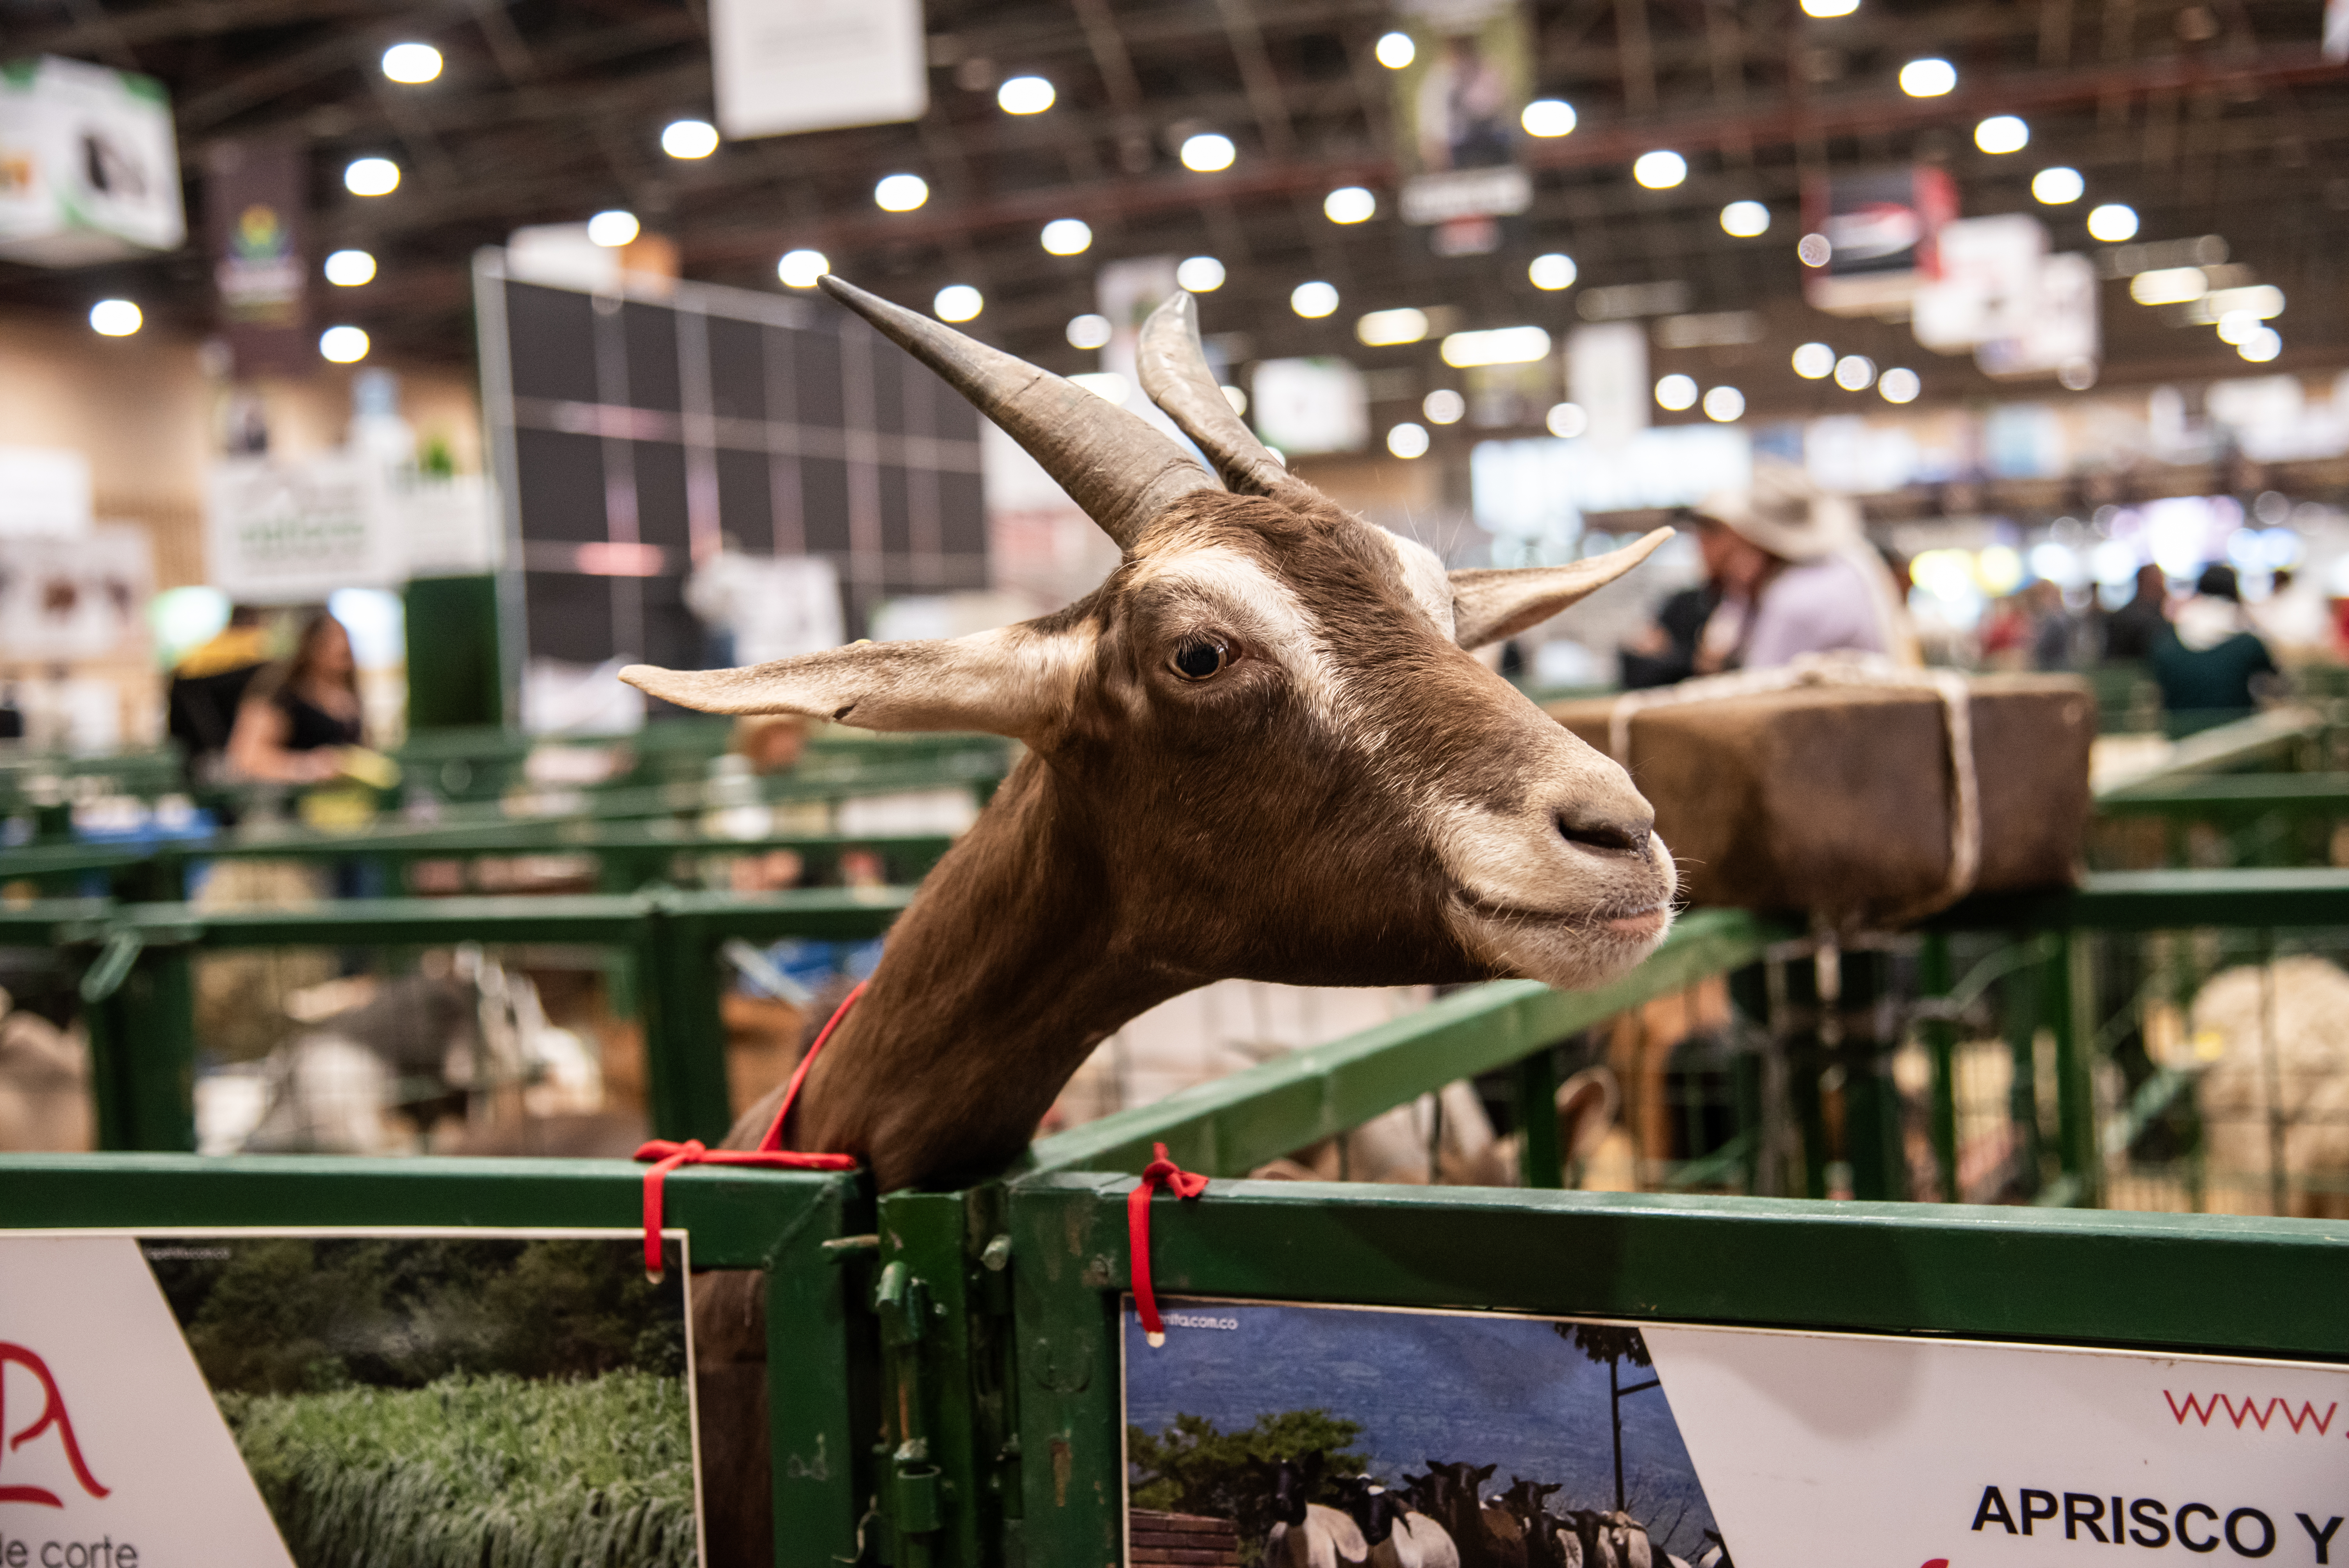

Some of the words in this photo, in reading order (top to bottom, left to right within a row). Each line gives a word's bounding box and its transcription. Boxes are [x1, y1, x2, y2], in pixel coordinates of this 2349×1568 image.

[0, 1533, 29, 1568] e
[40, 1534, 139, 1568] corte
[1971, 1485, 2276, 1558] APRISCO
[2294, 1512, 2345, 1565] Y
